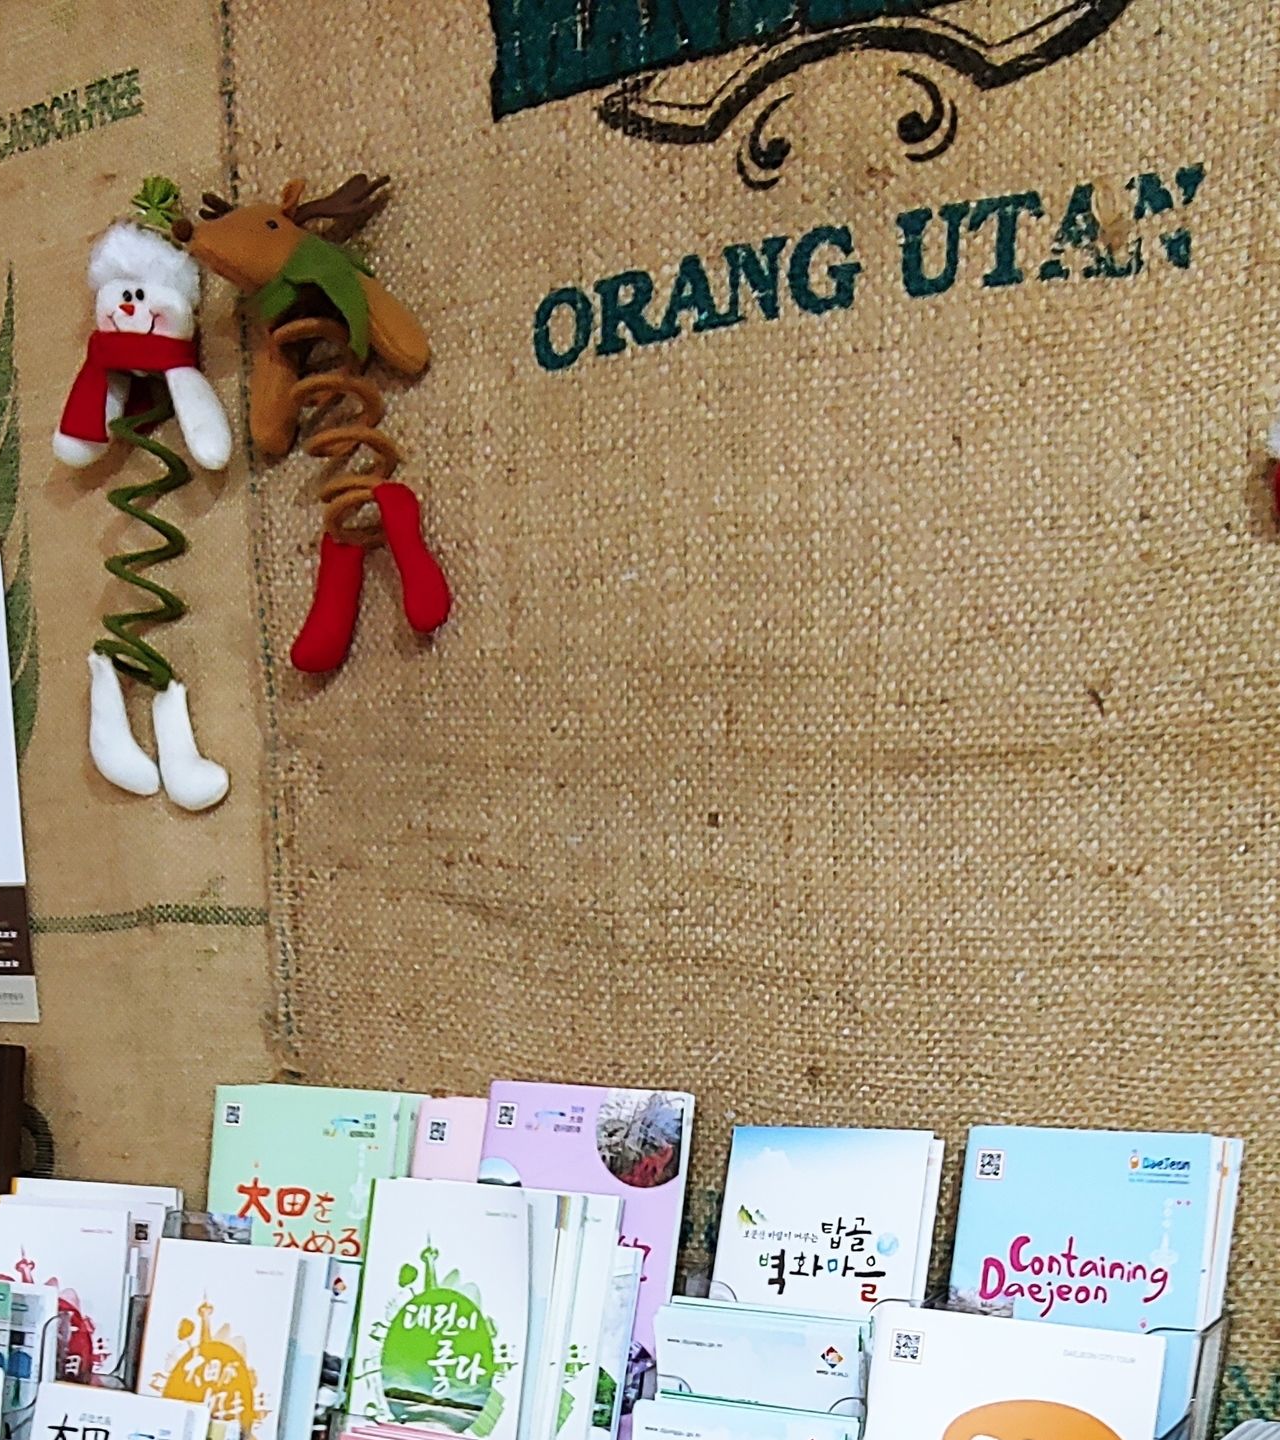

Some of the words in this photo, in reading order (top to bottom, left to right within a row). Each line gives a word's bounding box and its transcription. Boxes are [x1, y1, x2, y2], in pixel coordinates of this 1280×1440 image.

[532, 222, 863, 373] ORANG
[894, 161, 1206, 300] UTAN
[236, 1177, 335, 1223] 大田を
[821, 1217, 872, 1251] 탑골
[759, 1249, 886, 1302] 벽화마을
[978, 1256, 1109, 1318] Daejeon
[1008, 1235, 1169, 1303] Containing
[403, 1302, 478, 1336] 대전이
[427, 1340, 487, 1395] 좋다
